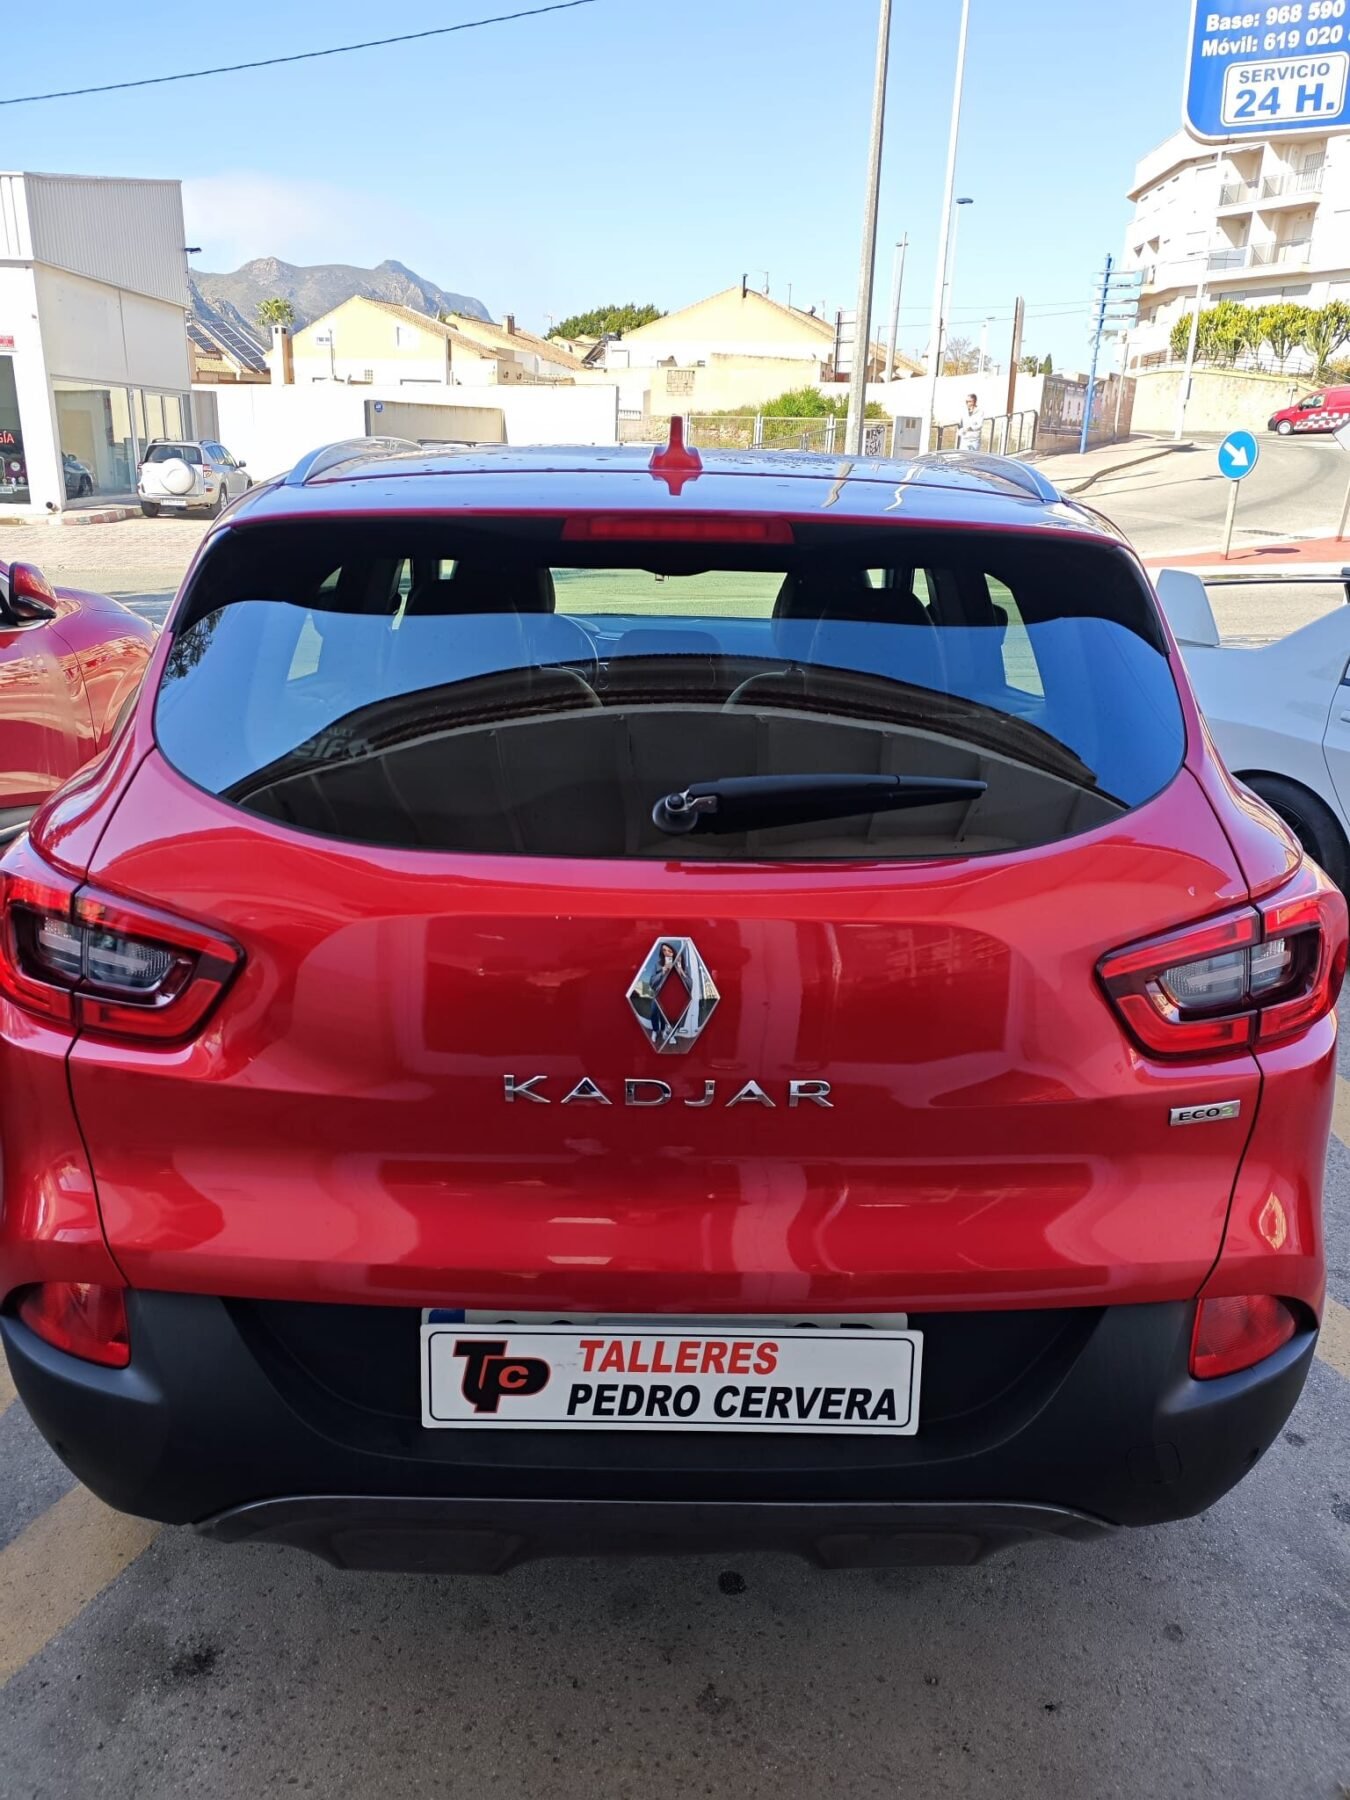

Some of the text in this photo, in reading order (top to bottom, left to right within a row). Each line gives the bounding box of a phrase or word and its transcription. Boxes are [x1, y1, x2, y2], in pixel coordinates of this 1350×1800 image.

[1206, 0, 1346, 32] Base: 968 590
[1202, 36, 1258, 57] Móvil:
[1264, 30, 1300, 51] 619
[1305, 24, 1344, 47] 020
[1239, 62, 1331, 84] SERVICIO
[1233, 83, 1335, 118] 24 H.
[503, 1074, 835, 1107] KADJAR
[579, 1340, 779, 1374] TALLERES
[566, 1383, 898, 1421] PEDRO CERVERA
